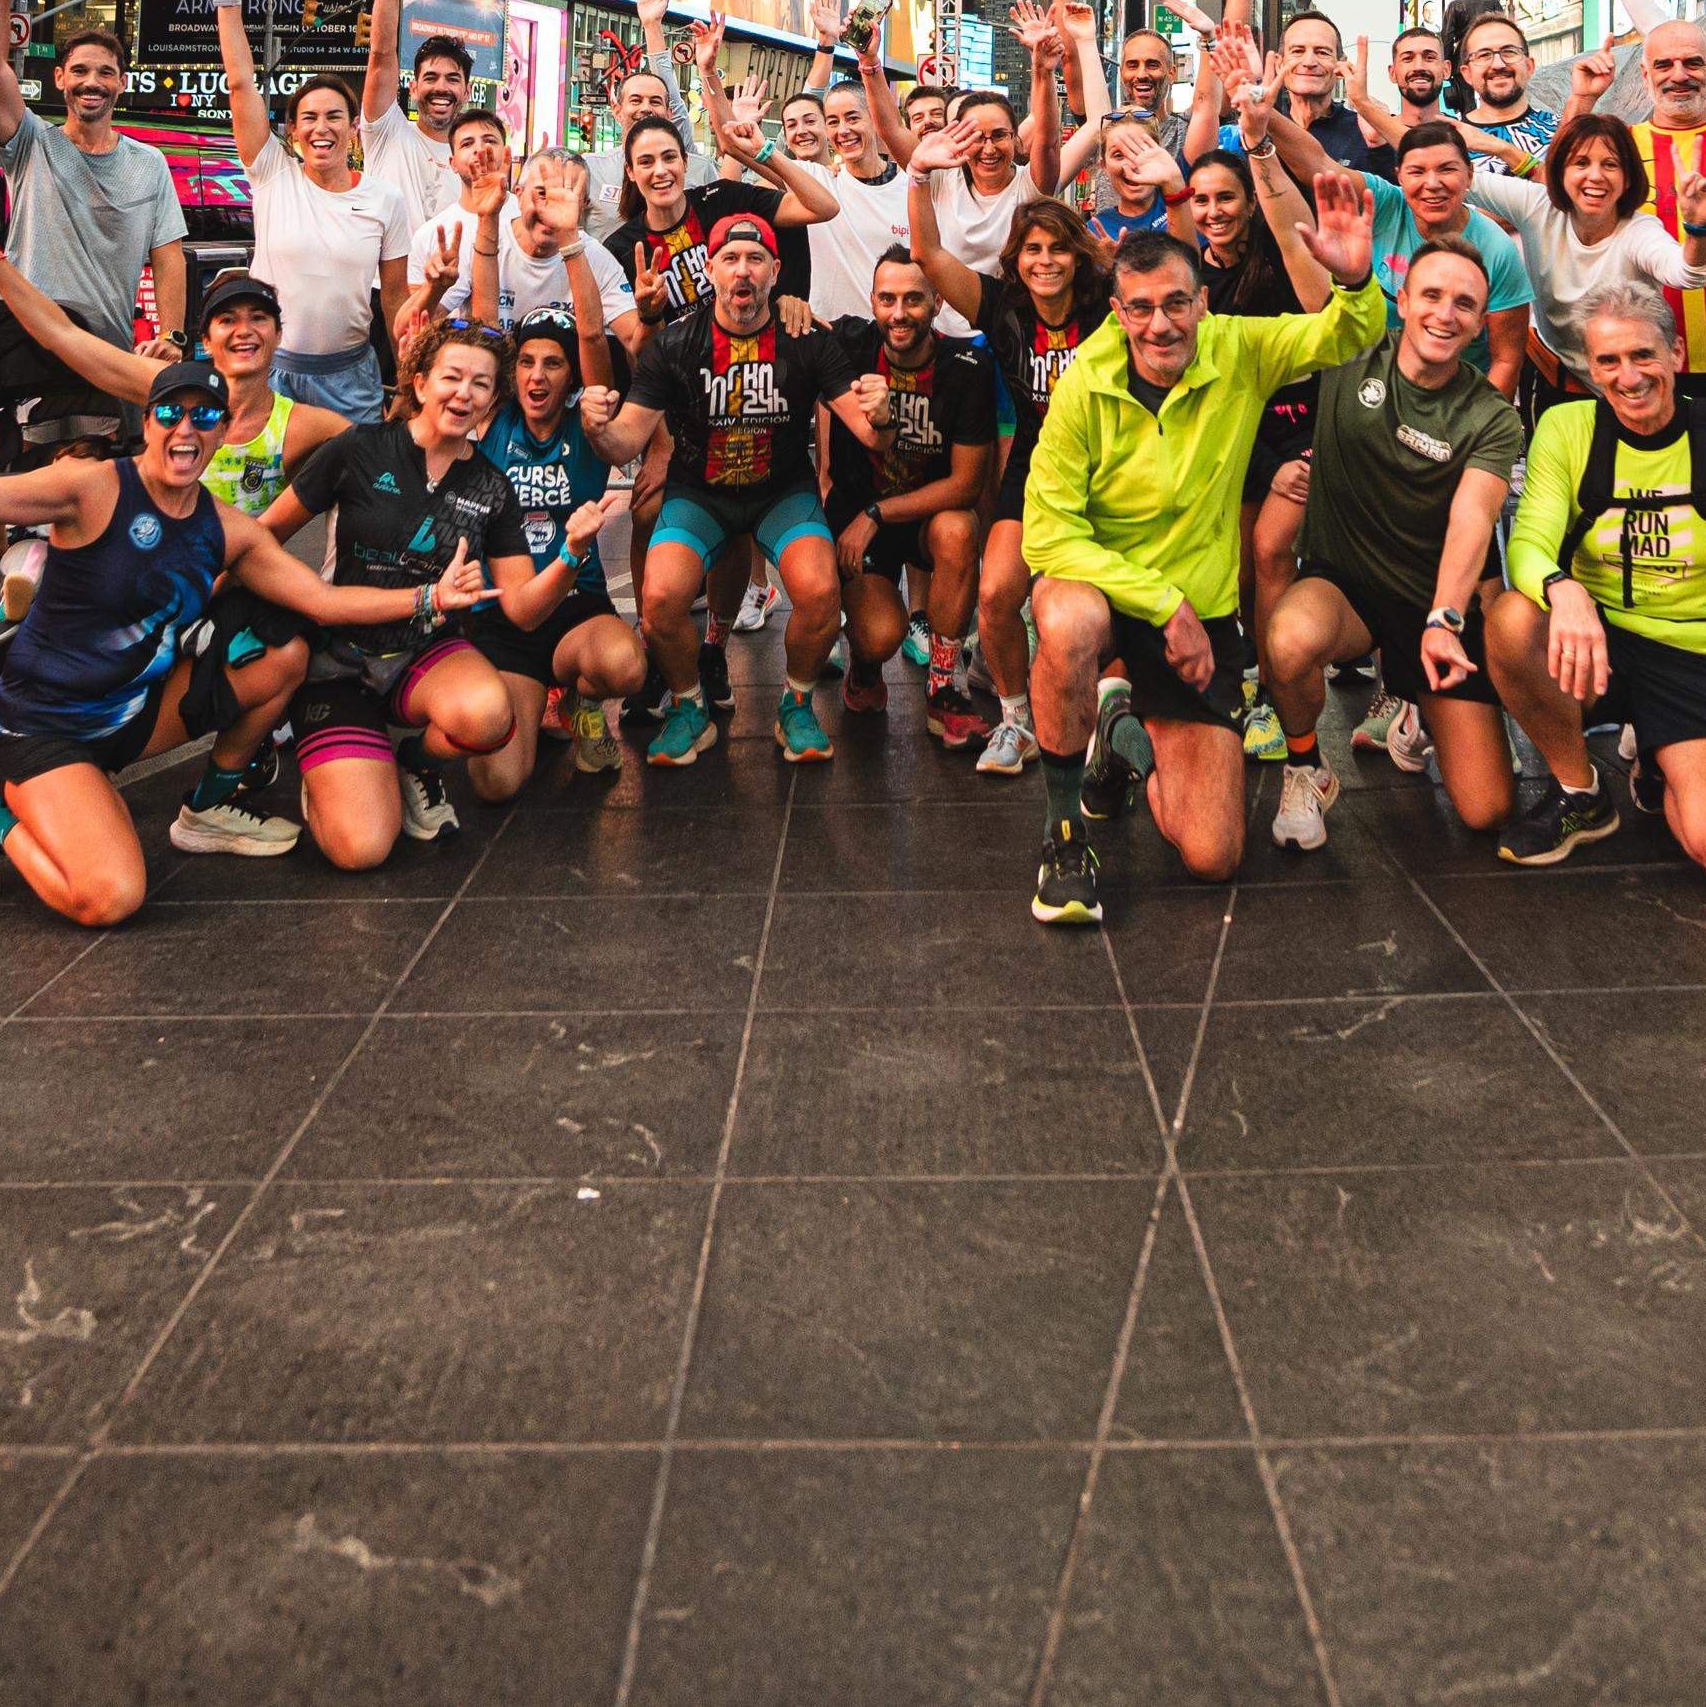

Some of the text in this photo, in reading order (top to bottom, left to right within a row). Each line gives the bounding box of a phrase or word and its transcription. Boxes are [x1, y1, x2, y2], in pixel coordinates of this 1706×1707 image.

[168, 24, 220, 33] BROADWAY
[191, 94, 216, 108] NY
[197, 109, 233, 119] SONY
[1624, 511, 1669, 535] RUN
[1620, 534, 1670, 558] MAD
